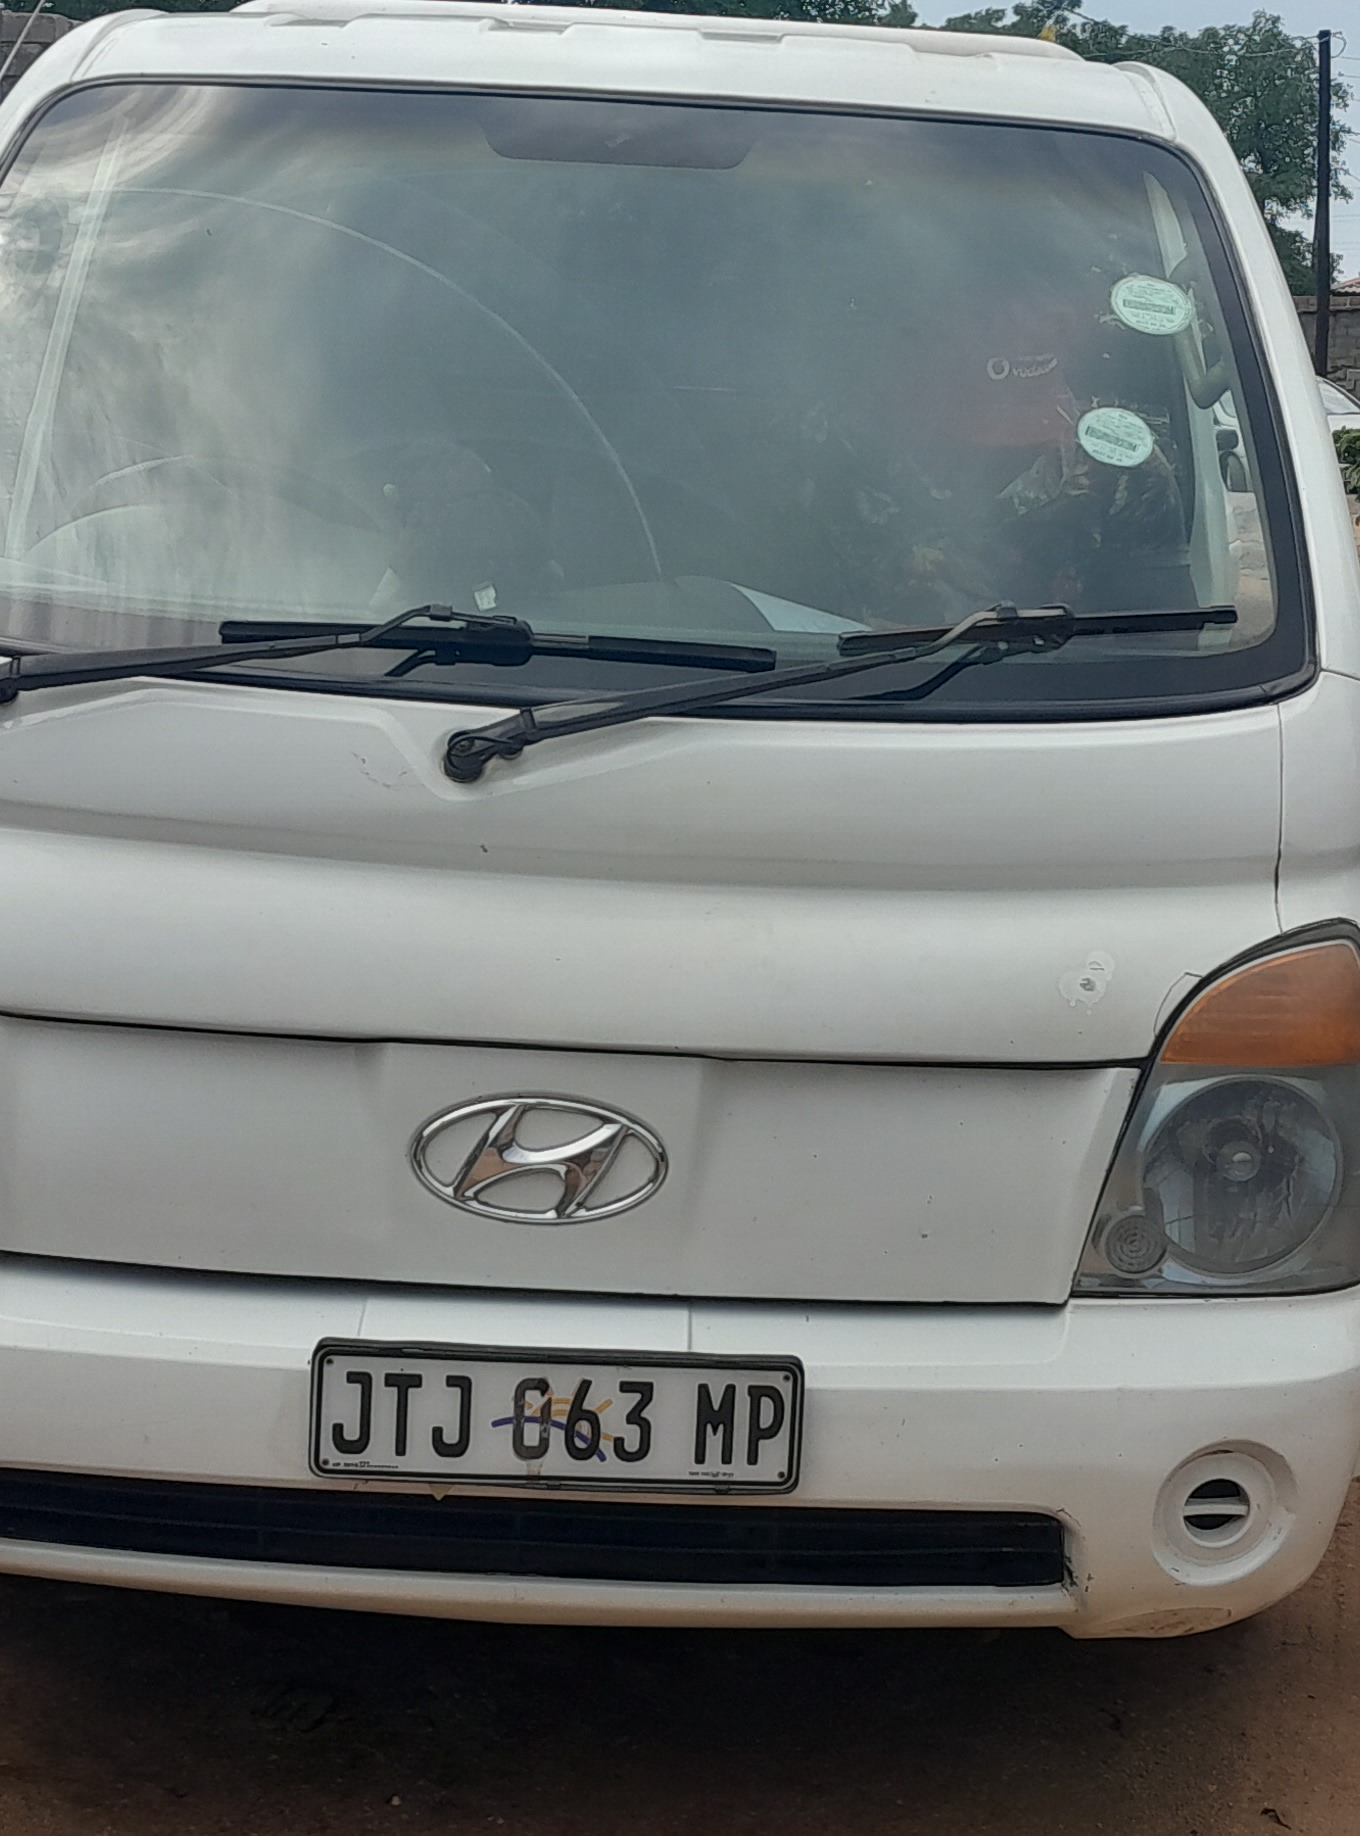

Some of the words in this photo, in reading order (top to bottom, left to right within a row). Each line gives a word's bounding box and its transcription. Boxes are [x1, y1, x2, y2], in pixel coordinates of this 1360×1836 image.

[331, 1370, 473, 1459] JTJ
[511, 1377, 654, 1463] 063
[694, 1383, 785, 1466] MP
